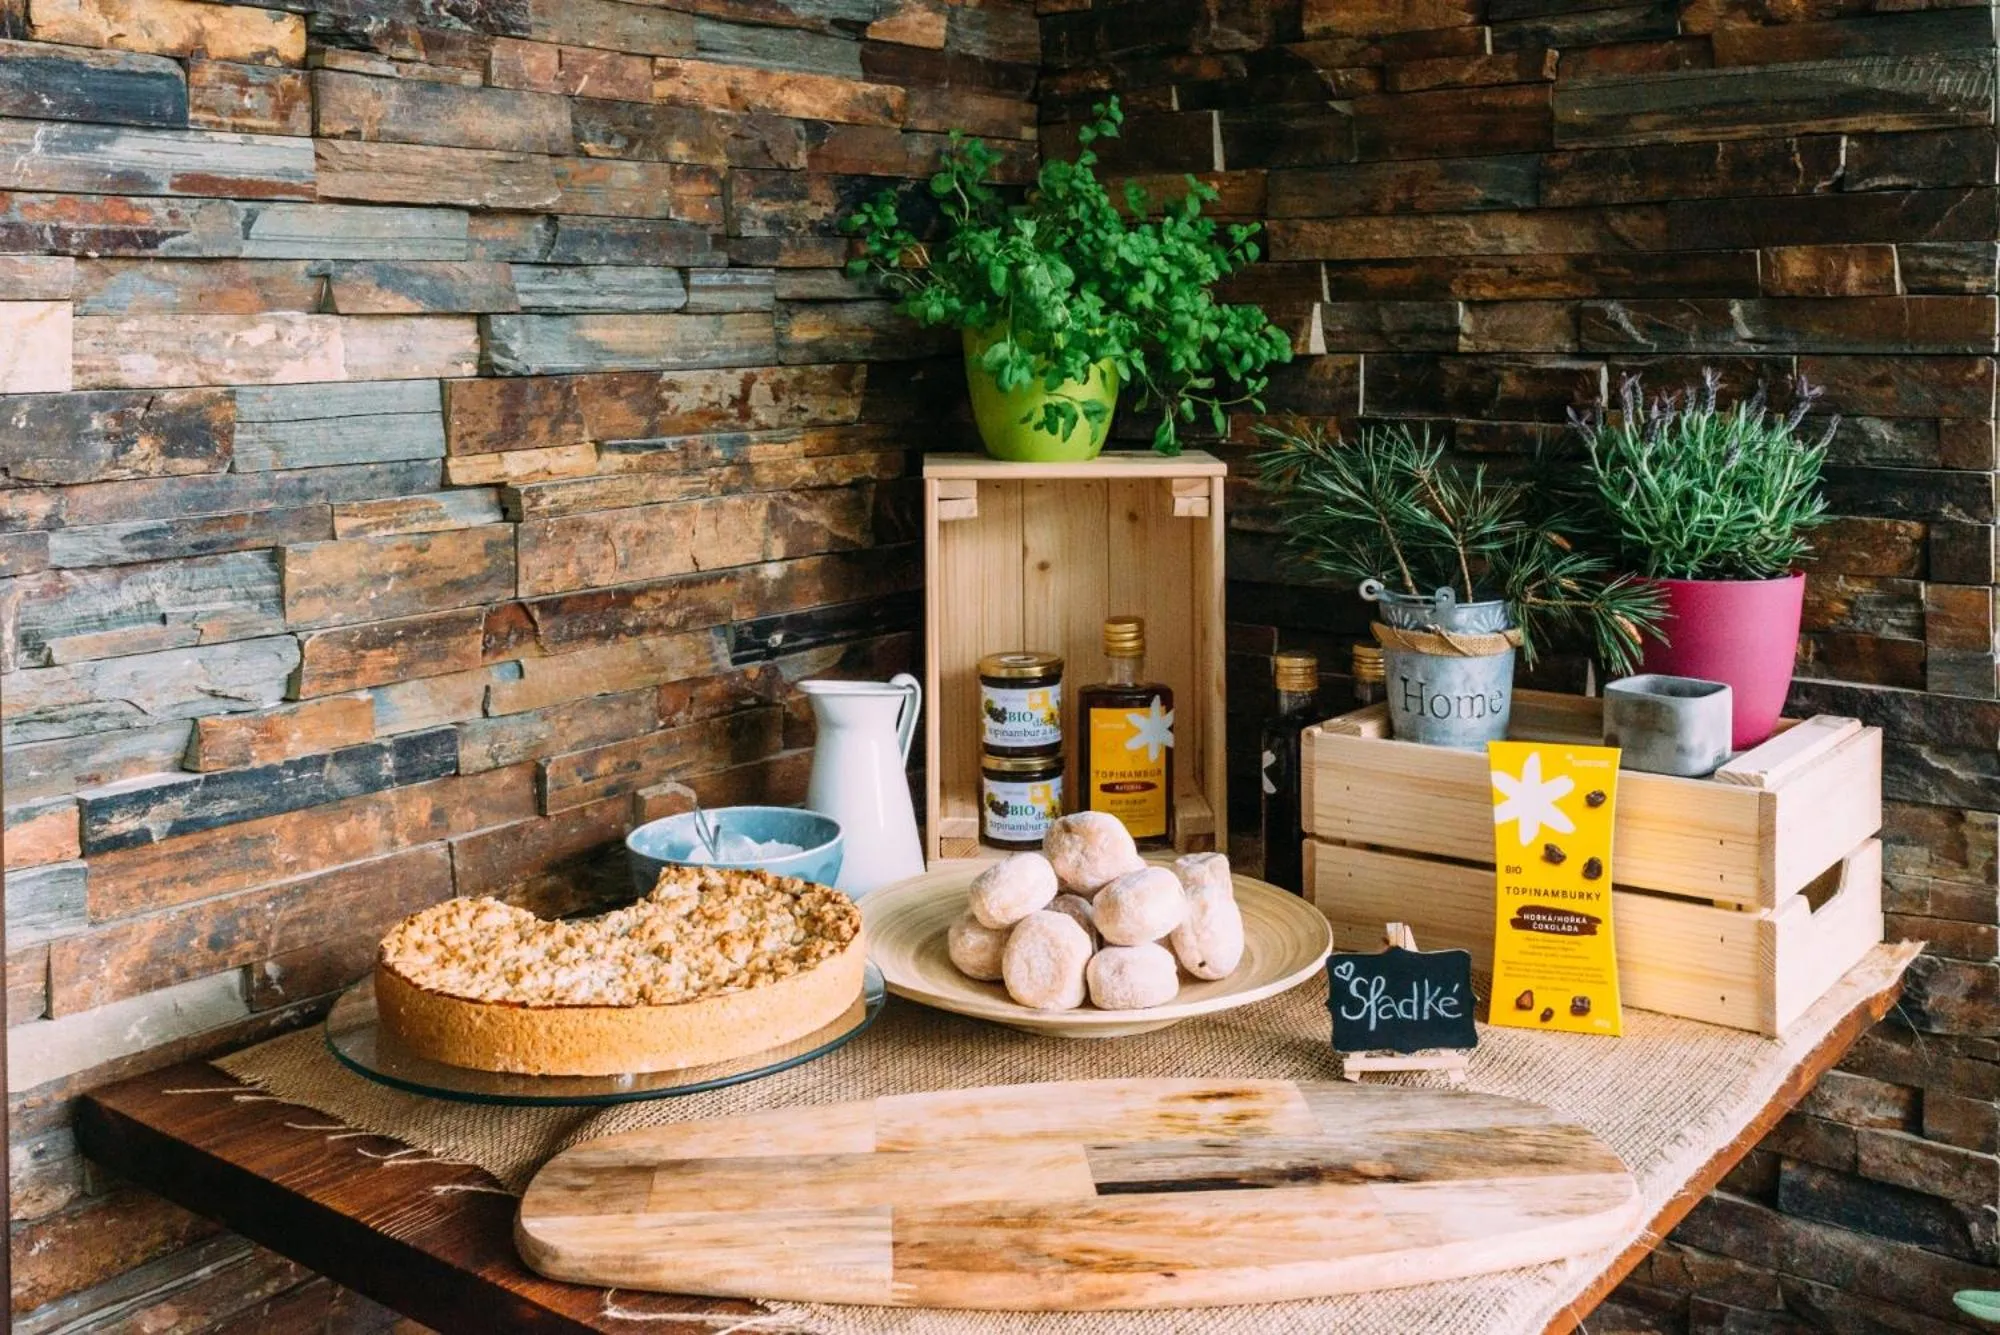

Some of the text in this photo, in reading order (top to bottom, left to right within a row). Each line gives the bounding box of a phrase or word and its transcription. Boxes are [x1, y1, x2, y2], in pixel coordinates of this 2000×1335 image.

[1401, 675, 1503, 720] Home
[1008, 711, 1033, 722] BIO
[1010, 805, 1036, 816] BIO
[1505, 865, 1522, 874] BIO
[1505, 886, 1601, 901] TOPINAMBURKY
[1341, 976, 1462, 1031] Sladké
